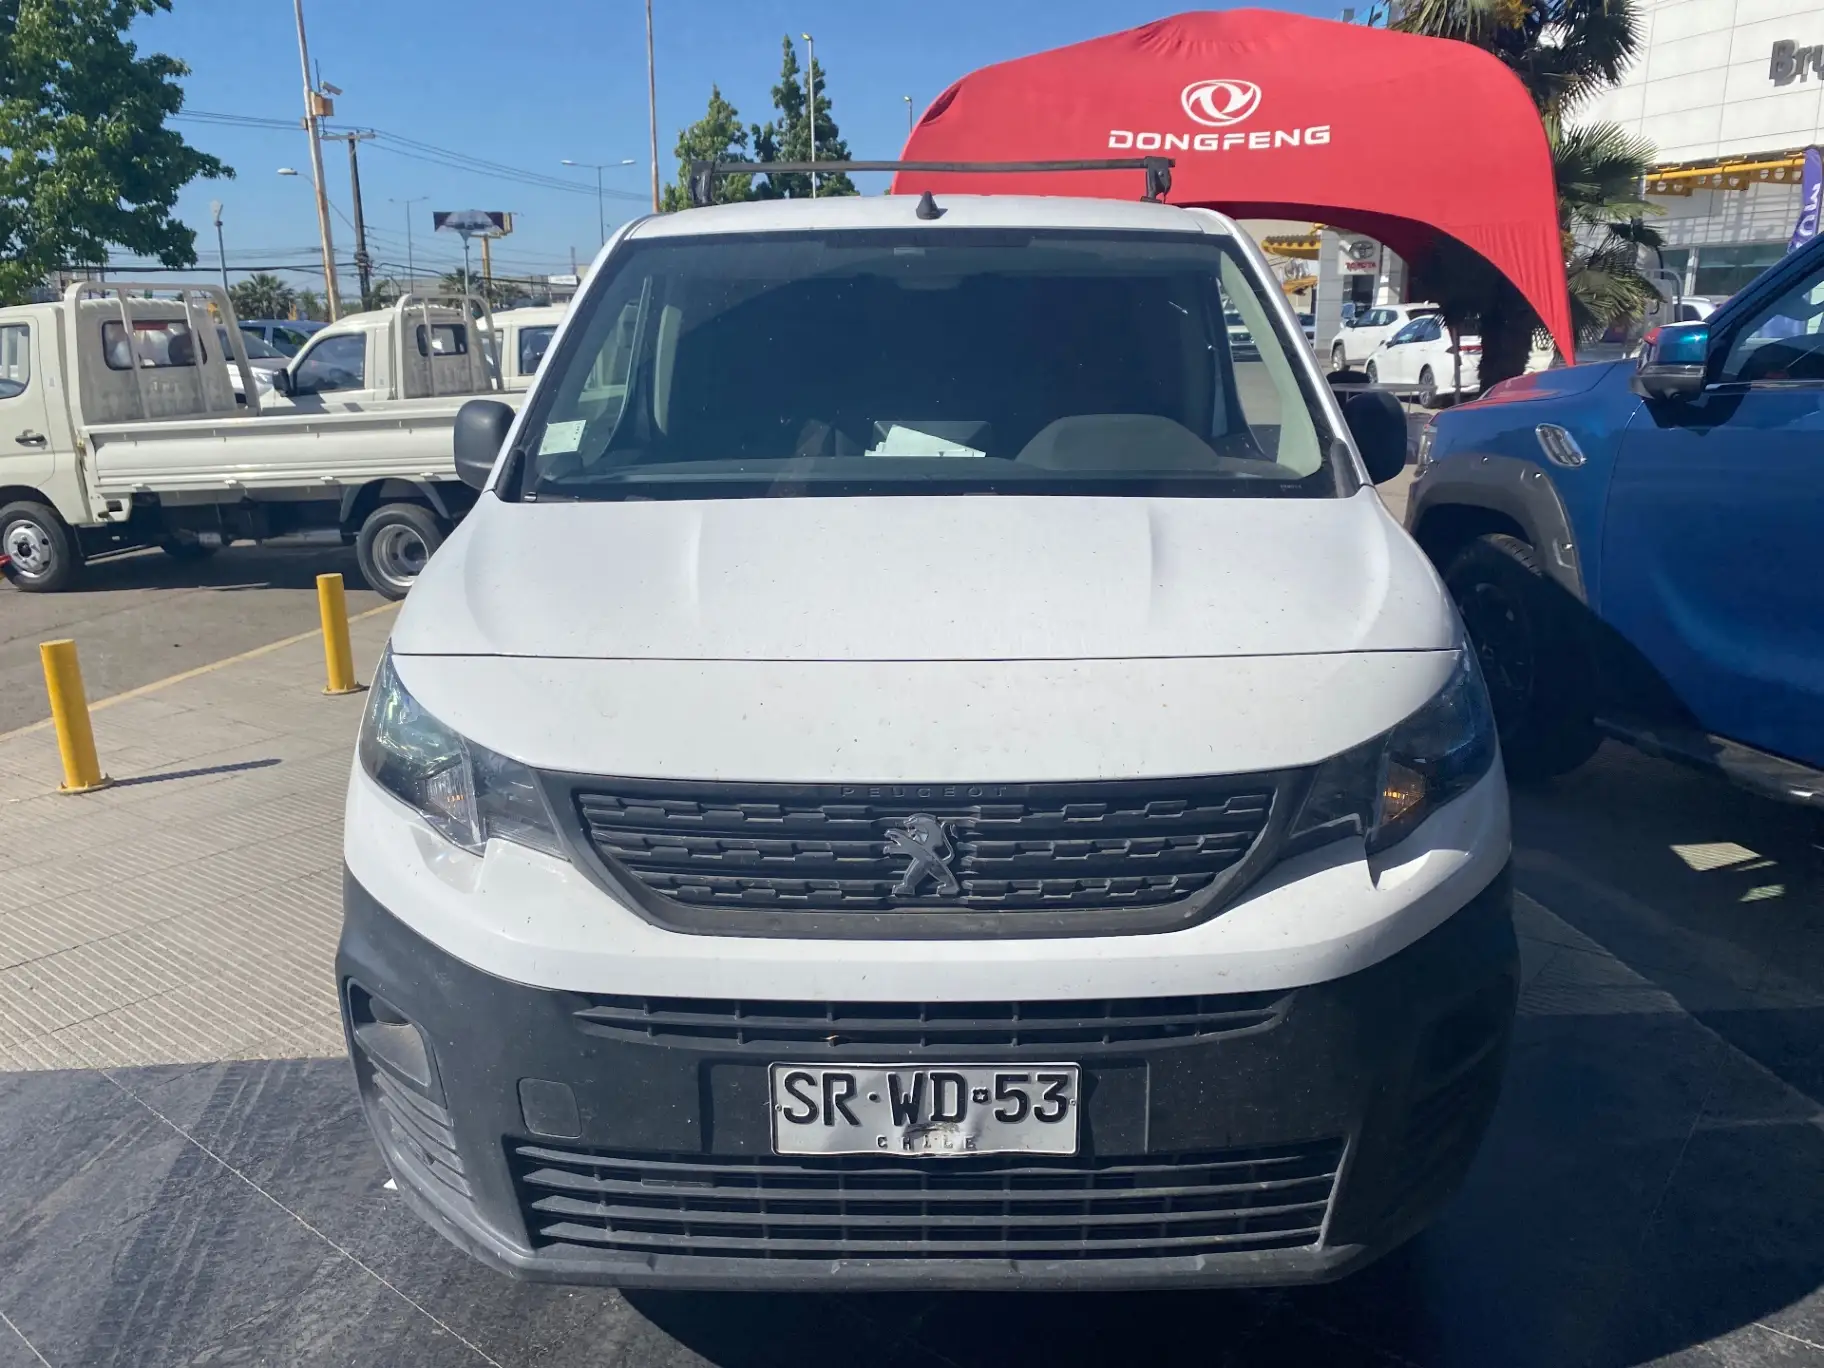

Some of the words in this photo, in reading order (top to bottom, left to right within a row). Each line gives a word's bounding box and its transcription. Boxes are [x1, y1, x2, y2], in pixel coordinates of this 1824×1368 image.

[1108, 125, 1331, 151] DONGFENG
[840, 785, 1007, 798] PEUGEOT
[875, 1134, 977, 1151] CHILE
